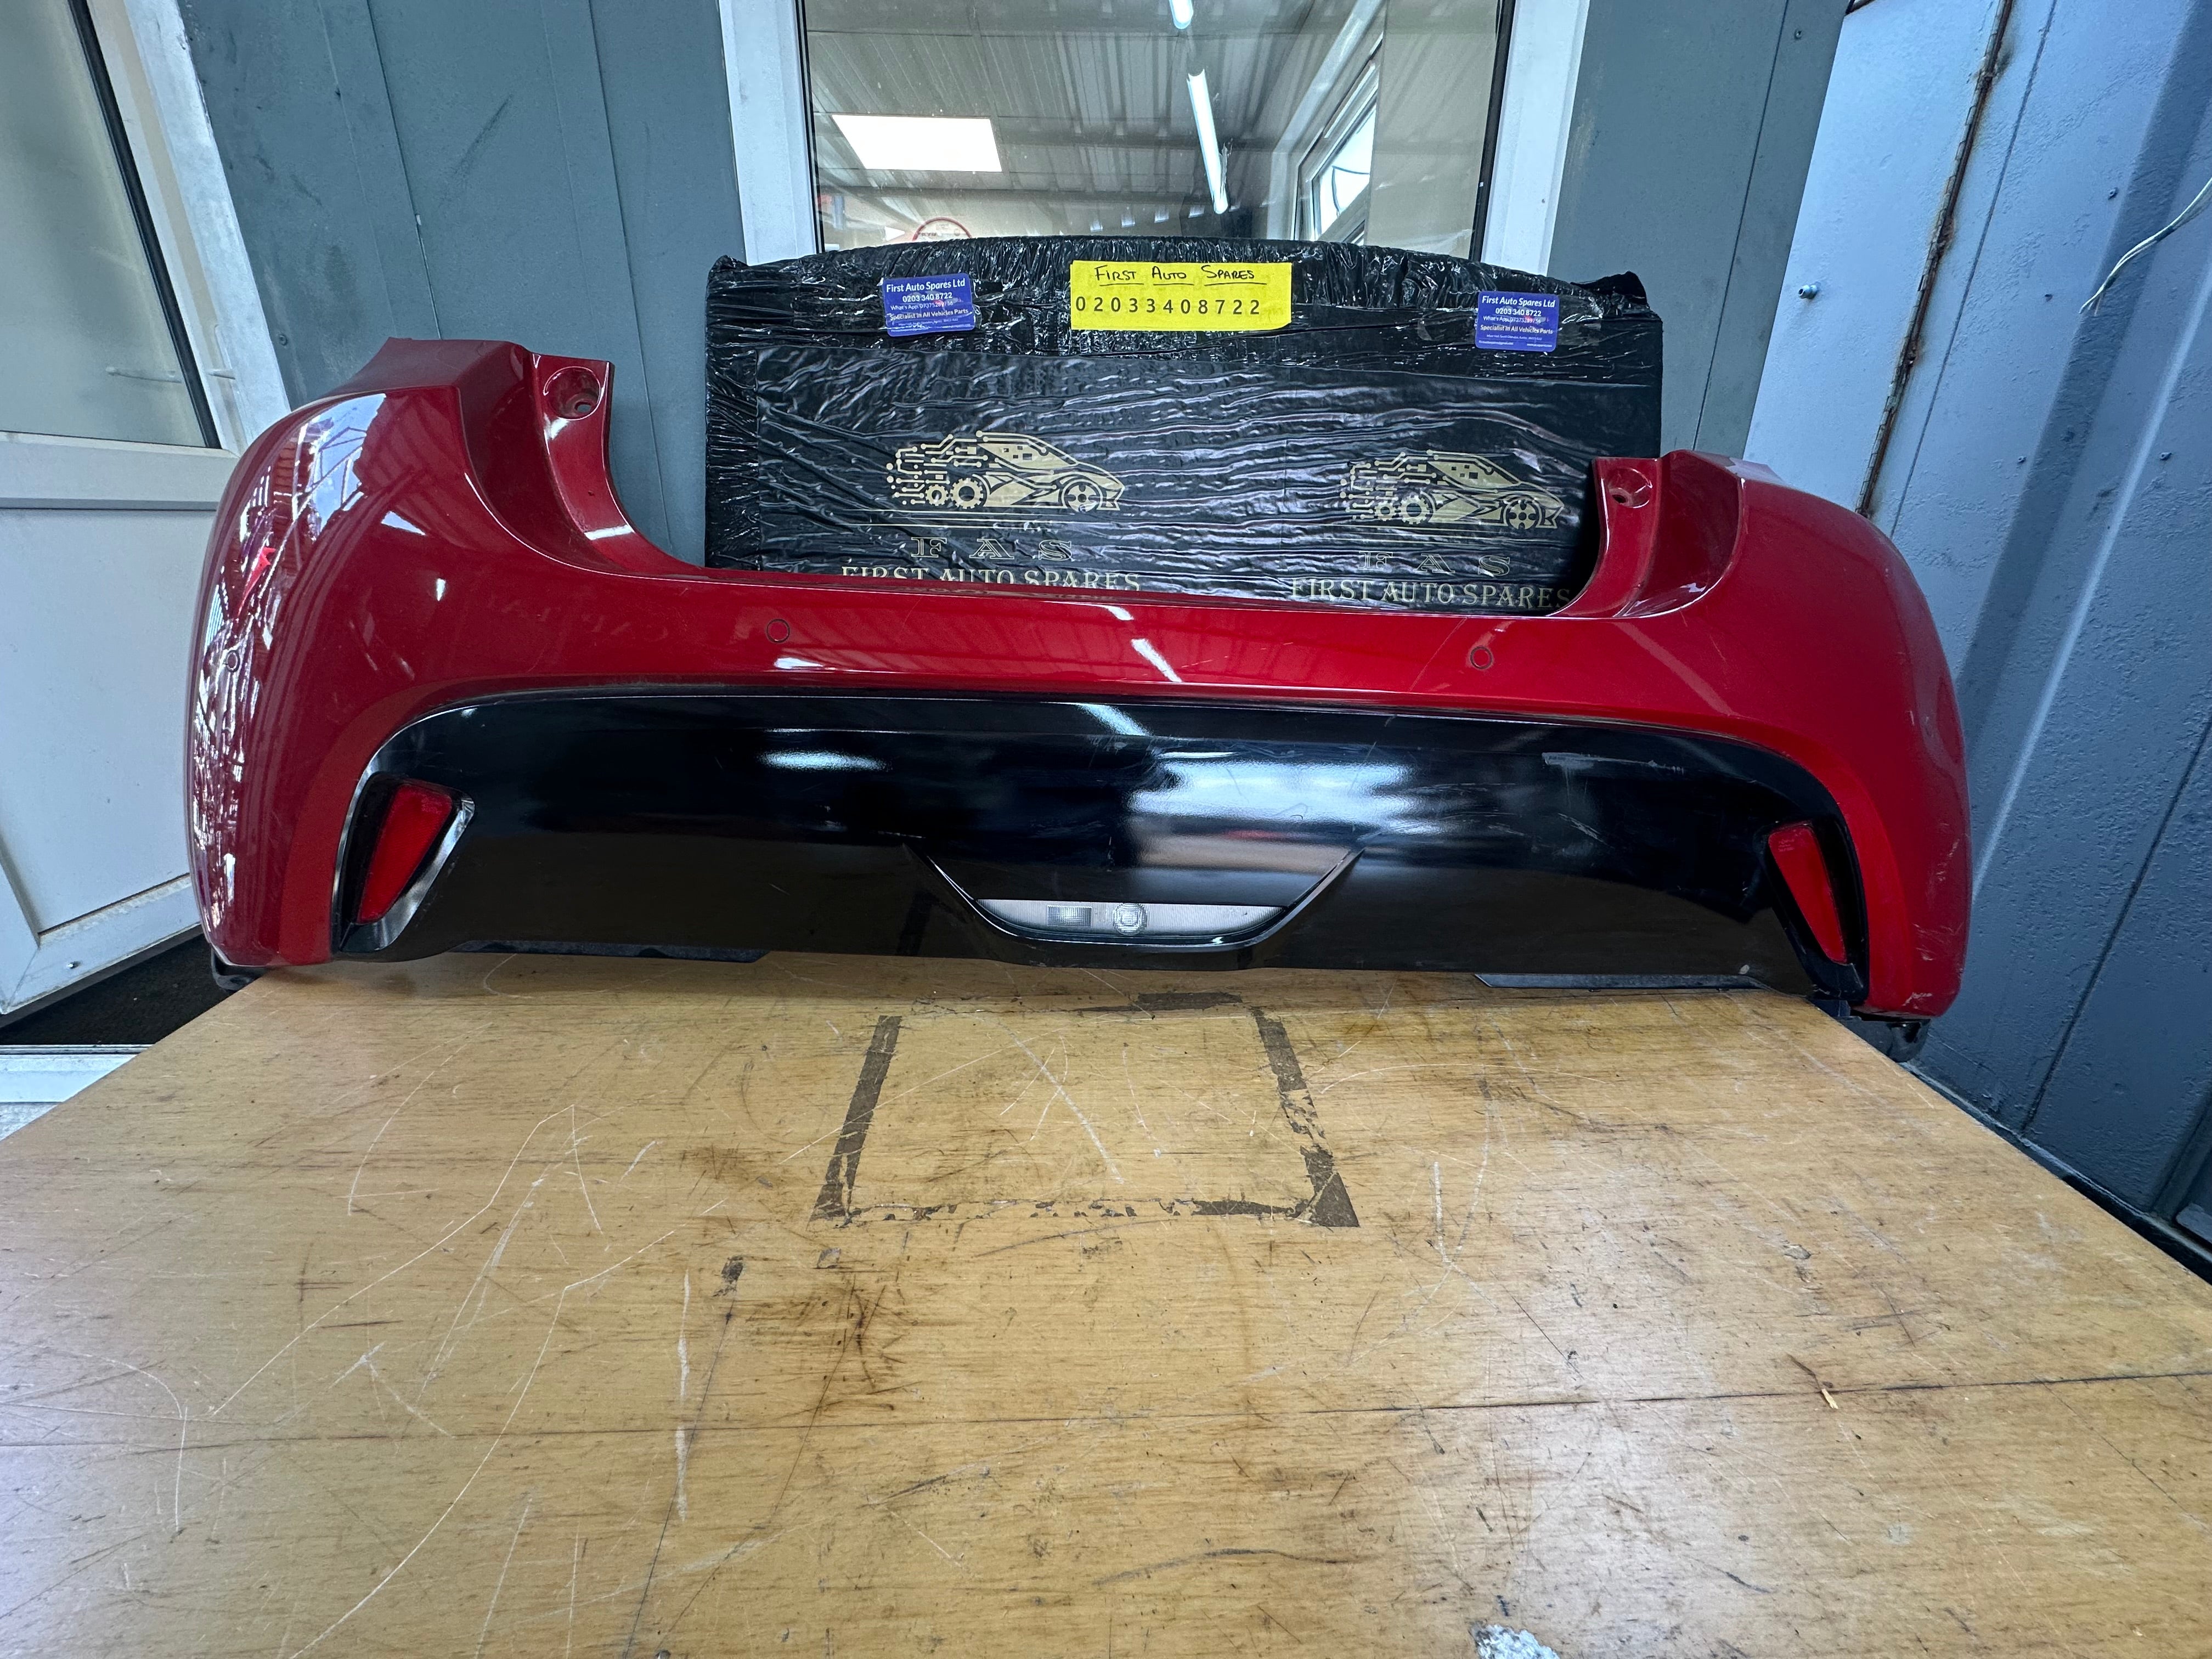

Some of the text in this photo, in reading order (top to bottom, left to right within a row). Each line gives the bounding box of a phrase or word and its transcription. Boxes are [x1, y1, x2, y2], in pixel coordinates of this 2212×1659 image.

[1094, 264, 1255, 281] FIRST AUTO SPARES
[886, 278, 966, 293] First Auto Spares Ltd
[902, 295, 920, 303] 0203
[935, 292, 953, 300] 8722
[1482, 296, 1556, 308] First Auto Spares Ltd
[1024, 570, 1141, 591] SPARES
[1292, 578, 1571, 609] FIRST AUTO SPARES
